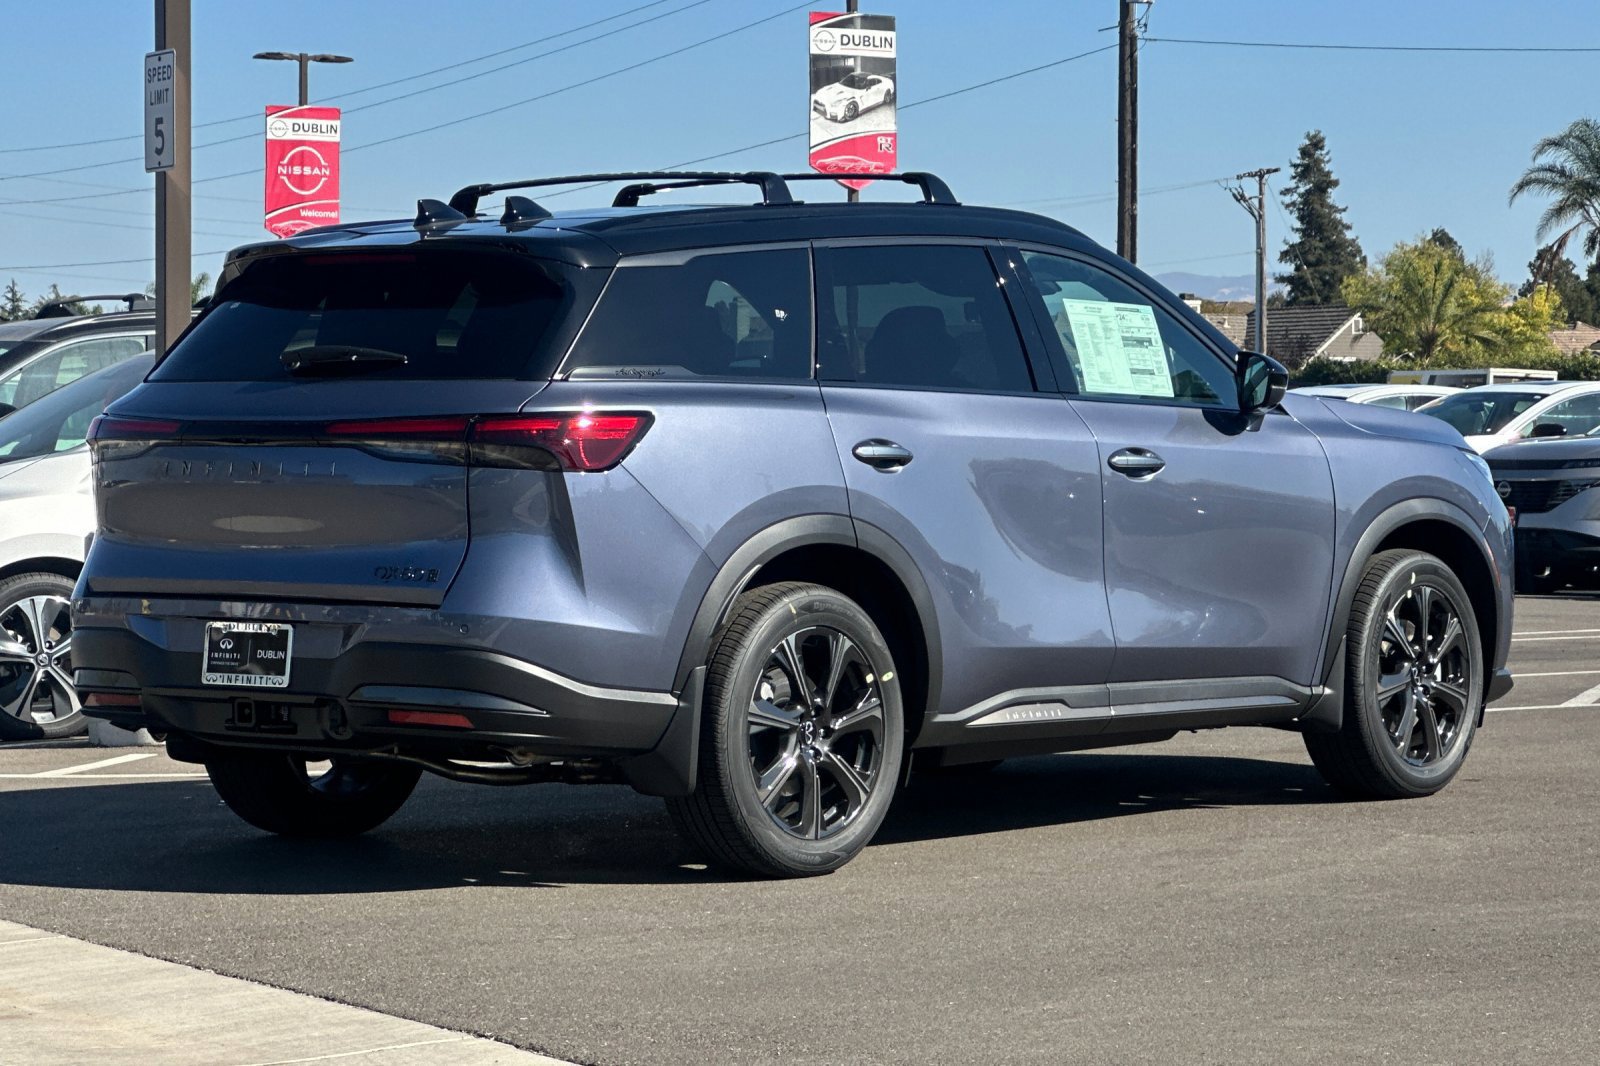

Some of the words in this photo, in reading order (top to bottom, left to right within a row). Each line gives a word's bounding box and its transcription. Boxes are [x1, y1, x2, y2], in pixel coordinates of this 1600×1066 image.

[840, 34, 893, 49] DUBLIN
[147, 65, 172, 83] SPEED
[150, 88, 169, 106] LIMIT
[292, 122, 338, 134] DUBLIN
[154, 117, 165, 156] 5
[277, 165, 330, 176] NISSAN
[300, 208, 338, 218] Welcome!
[164, 460, 336, 477] INFINITI
[257, 649, 285, 660] DUBLIN
[221, 674, 269, 684] INFINITI
[1006, 708, 1062, 720] INFINITI
